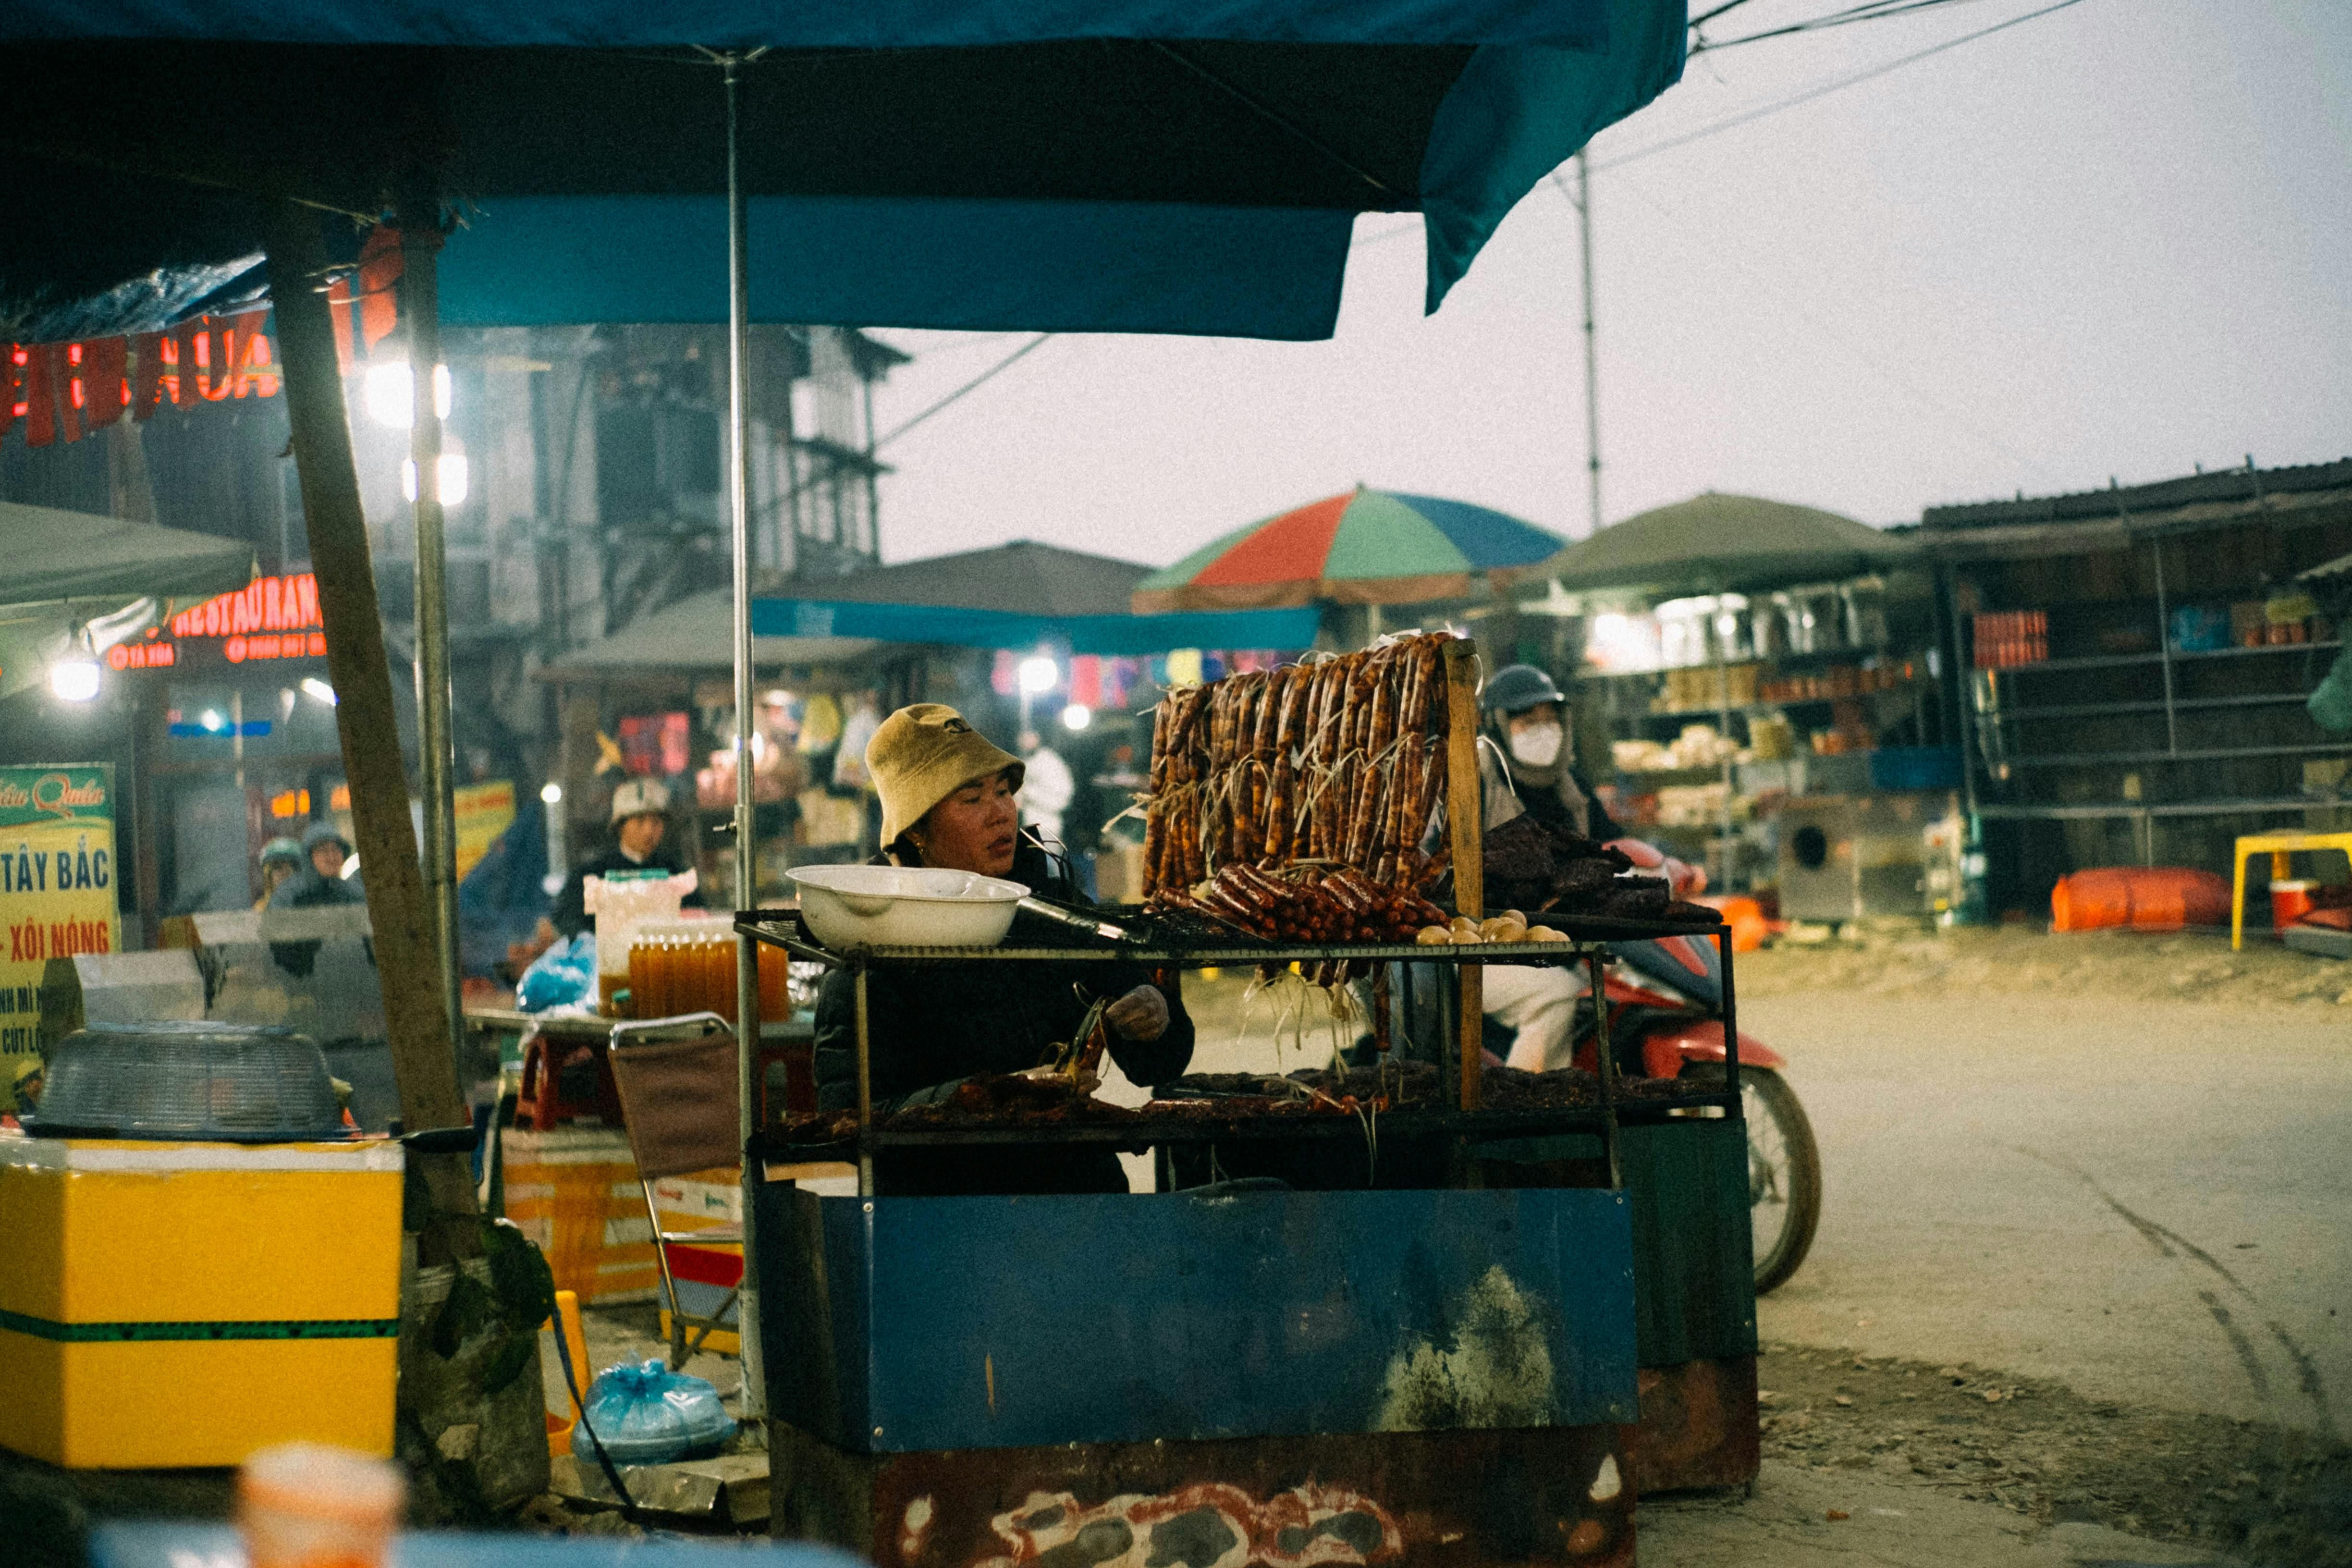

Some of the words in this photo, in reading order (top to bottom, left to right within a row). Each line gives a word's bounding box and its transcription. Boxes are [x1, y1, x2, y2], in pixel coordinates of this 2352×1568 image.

[0, 843, 47, 892] TÂY
[57, 833, 109, 891] BẮC
[10, 915, 46, 963] XÔI
[50, 914, 109, 957] NÓNG
